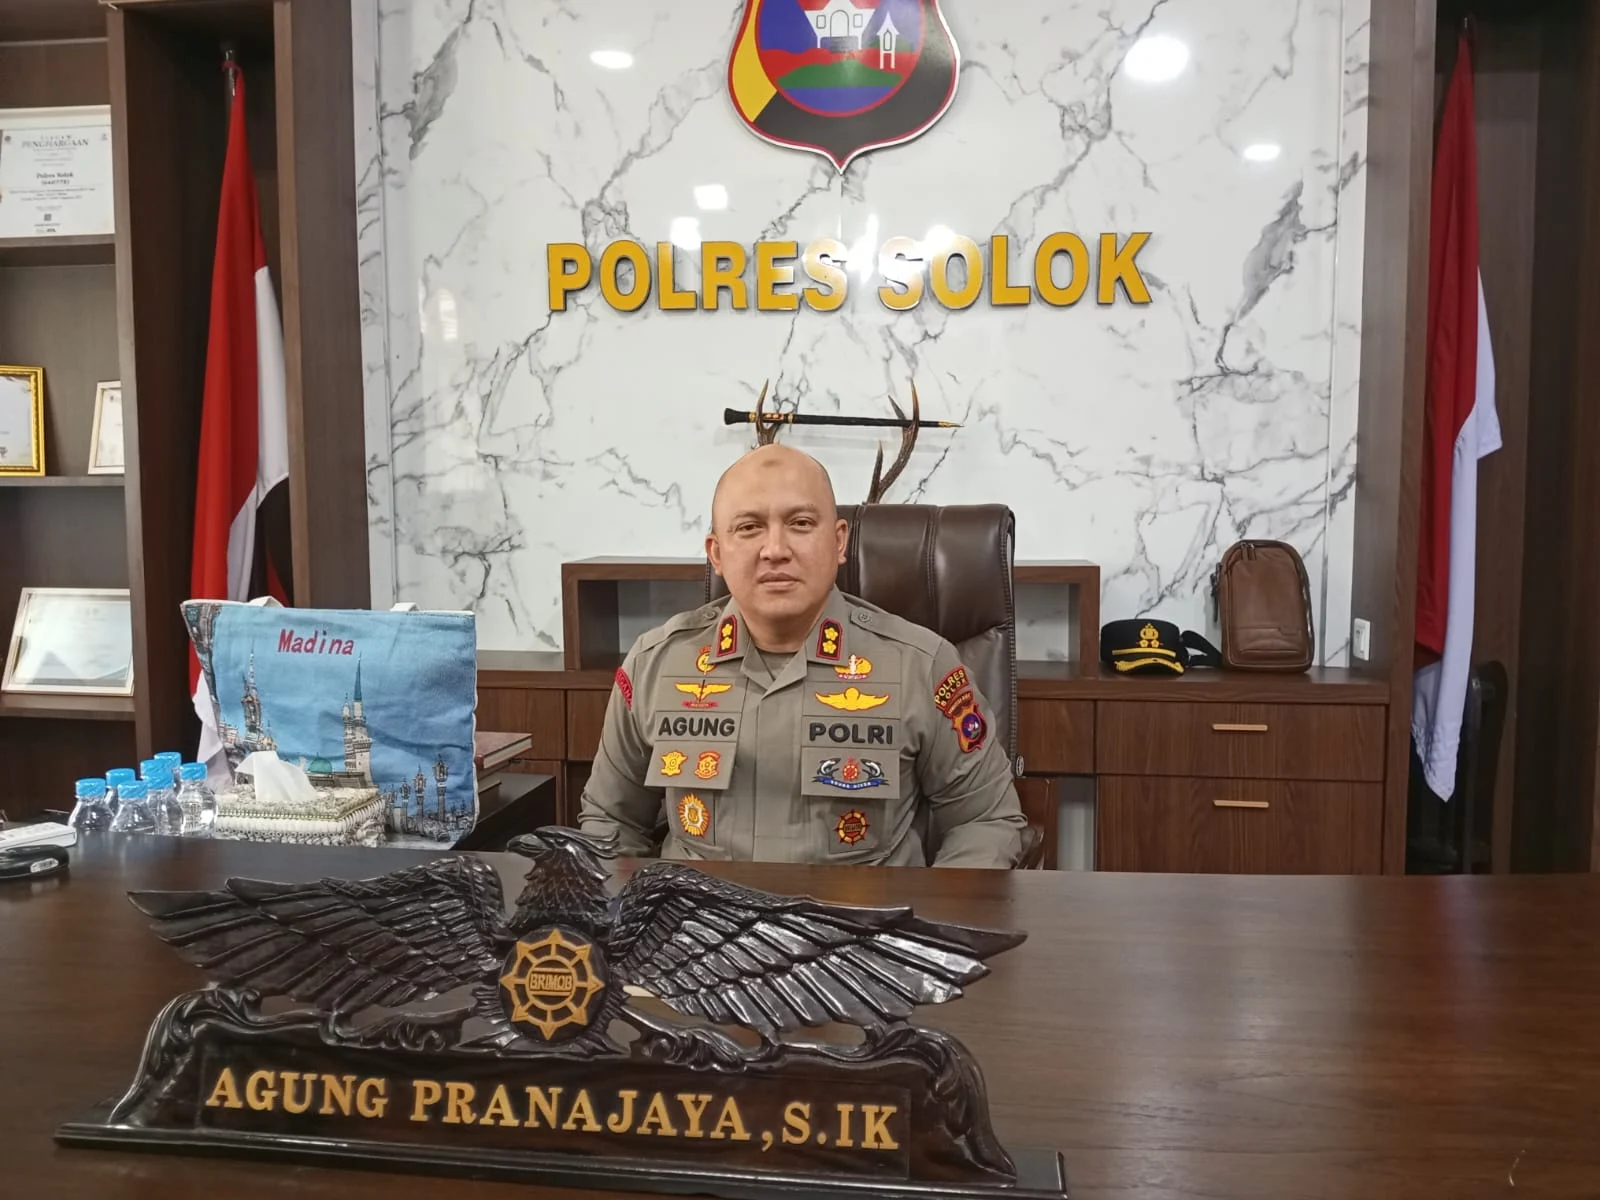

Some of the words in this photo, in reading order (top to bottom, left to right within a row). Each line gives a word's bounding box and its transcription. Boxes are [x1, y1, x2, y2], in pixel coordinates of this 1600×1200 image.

[547, 240, 848, 312] POLRES
[877, 232, 1153, 312] SOLOK
[278, 628, 354, 655] Madina
[934, 669, 965, 704] POLRES
[658, 716, 735, 737] AGUNG
[809, 722, 893, 744] POLRI
[529, 973, 573, 992] BRIMOB
[205, 1067, 388, 1118] AGUNG
